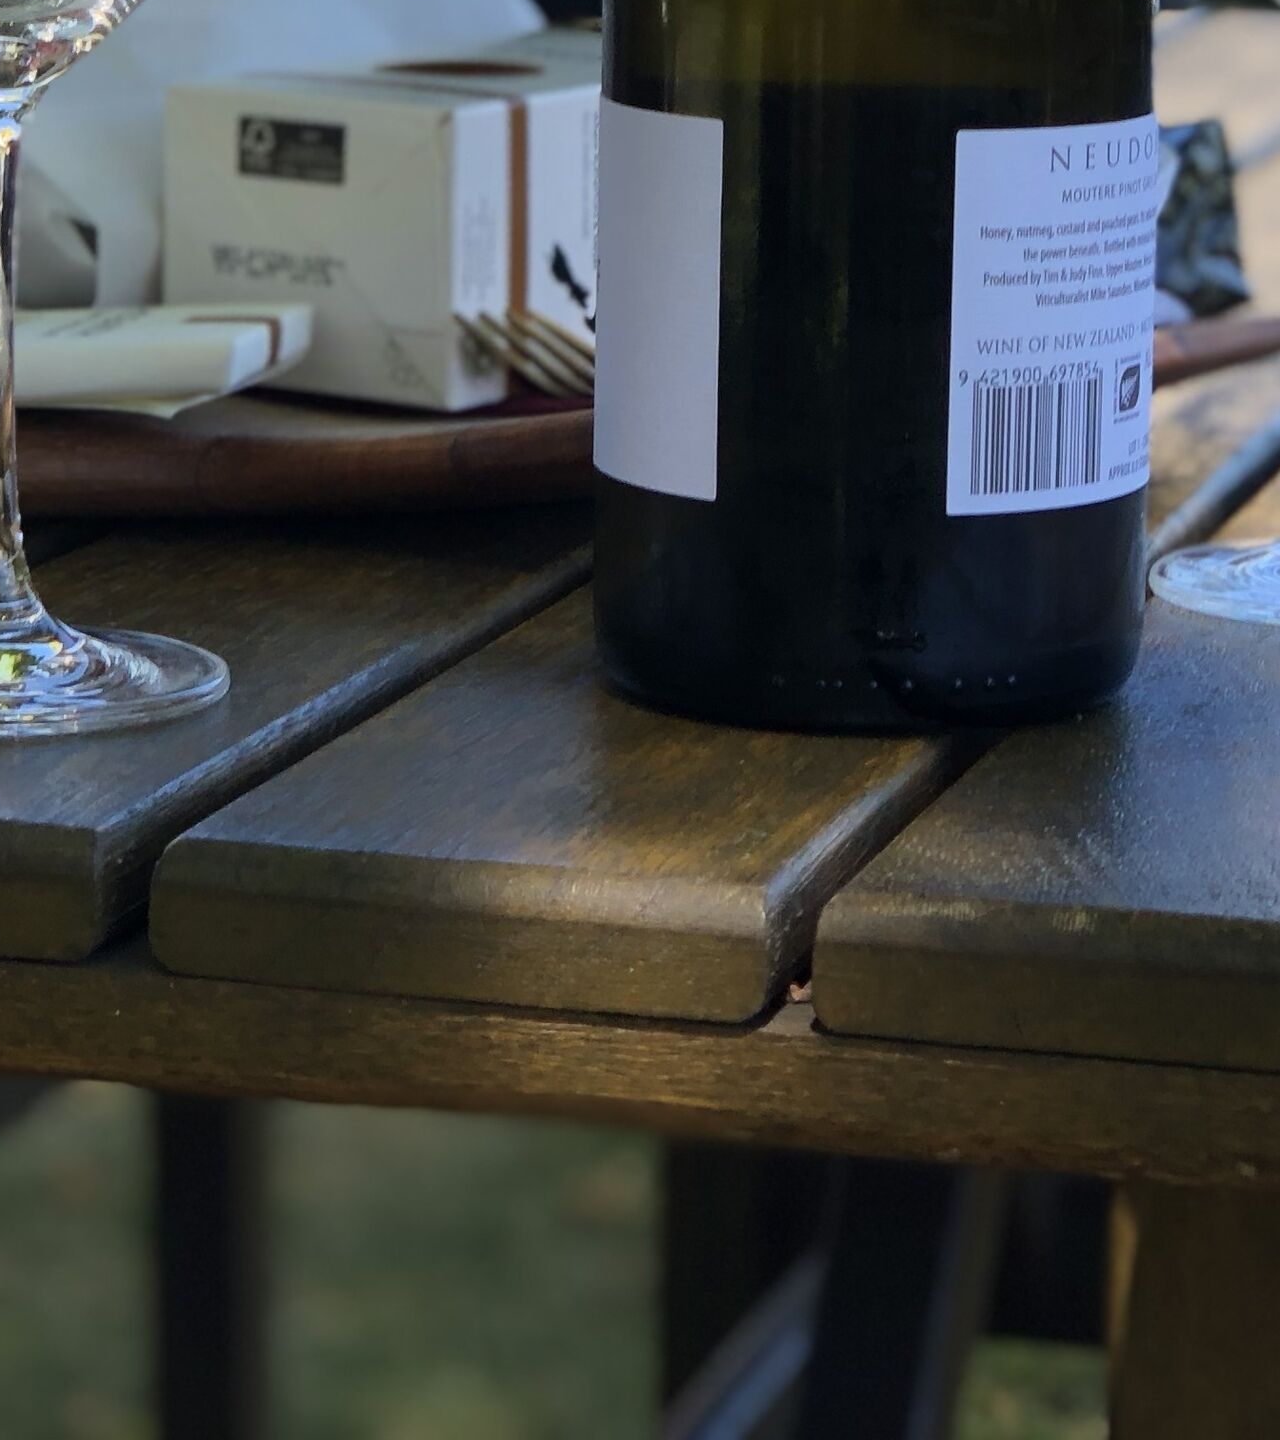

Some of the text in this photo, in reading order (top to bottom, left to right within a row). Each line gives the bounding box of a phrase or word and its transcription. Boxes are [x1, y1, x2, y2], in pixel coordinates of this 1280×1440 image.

[1061, 183, 1116, 204] MOUTERE
[980, 225, 1014, 242] Honey,
[1016, 224, 1054, 241] nutmeg,
[1056, 219, 1085, 236] custard
[1086, 217, 1100, 234] and
[1023, 247, 1038, 262] the
[1040, 246, 1067, 263] power
[983, 270, 1029, 288] Produced
[1030, 270, 1042, 288] by
[1044, 268, 1058, 284] Tim
[1060, 267, 1068, 283] &
[977, 336, 1023, 355] WINE
[1028, 335, 1049, 353] OF
[1054, 331, 1086, 351] NEW
[1089, 323, 1135, 348] ZEALAND
[958, 360, 1100, 387] 9 421900 697854
